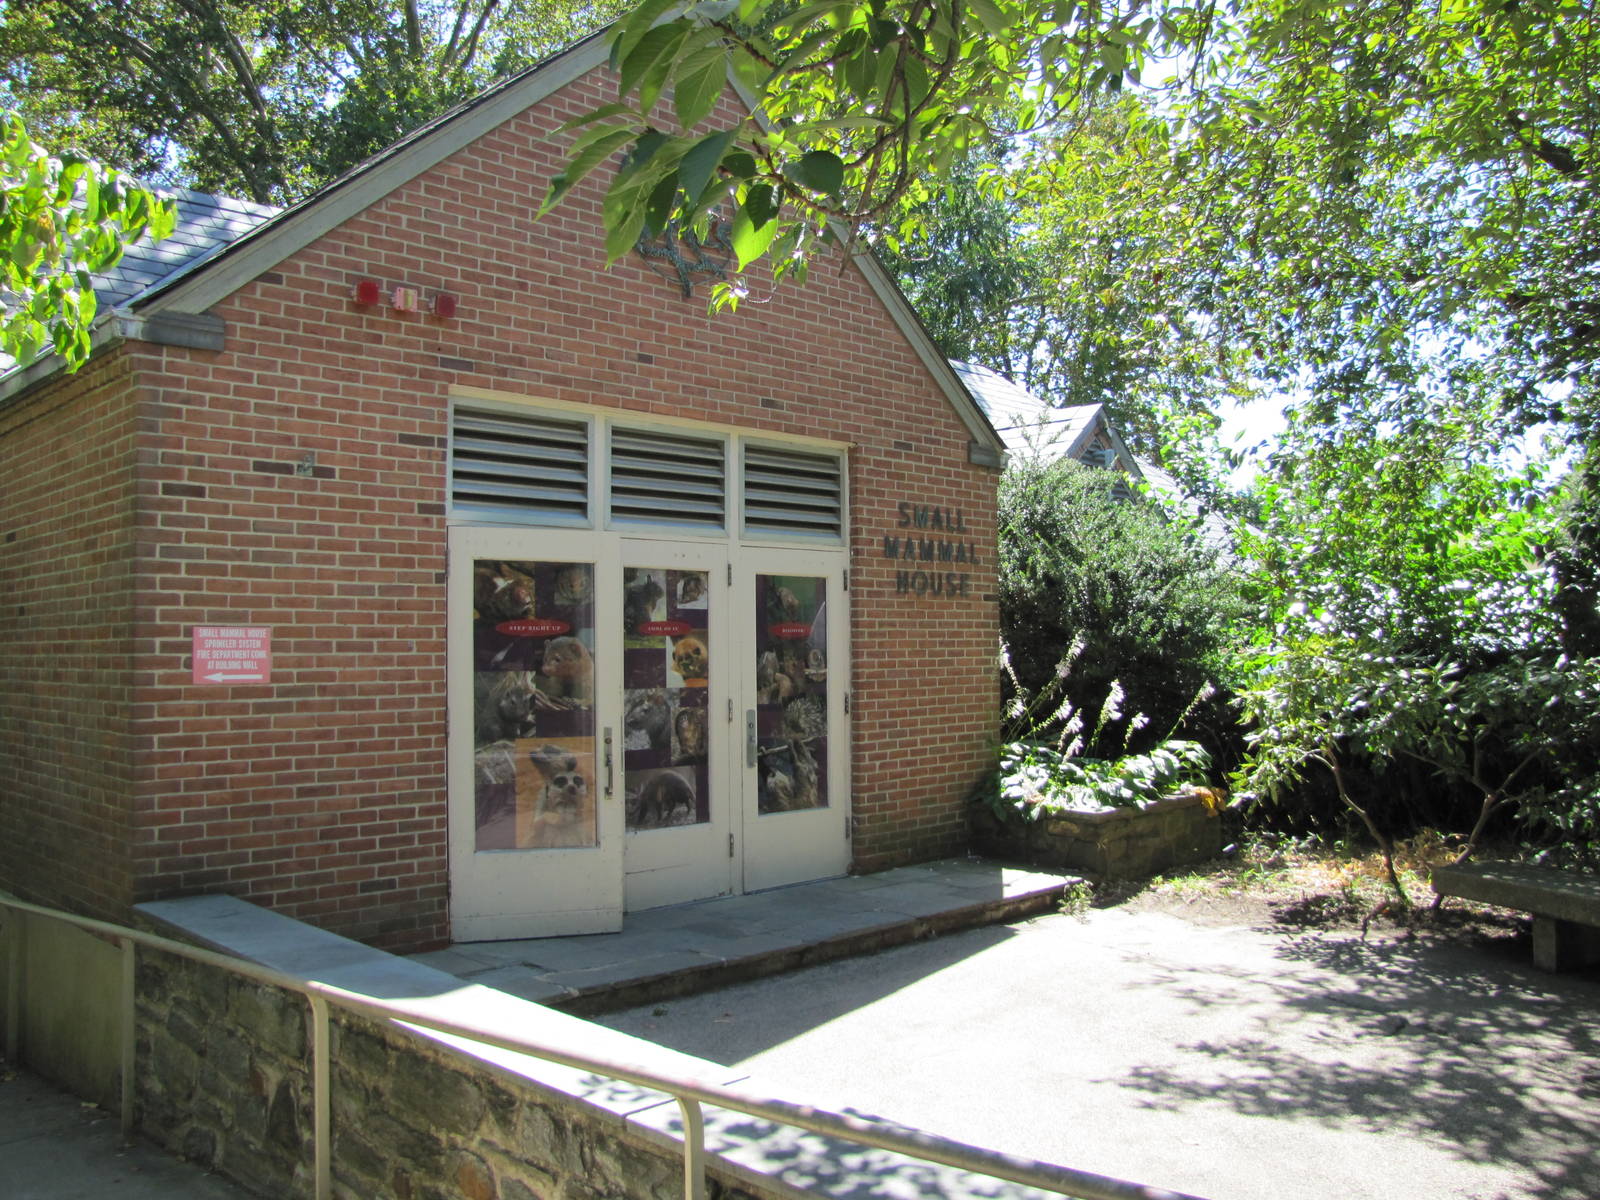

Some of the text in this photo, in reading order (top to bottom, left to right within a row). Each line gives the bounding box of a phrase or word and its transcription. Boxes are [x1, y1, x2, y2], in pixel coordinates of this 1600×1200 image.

[898, 501, 966, 533] SMALL
[884, 535, 980, 565] MAMMAL
[896, 569, 969, 597] HOUSE
[199, 628, 267, 639] SMALL MAMMAL HOUSE
[204, 639, 262, 649] SPRINKLER SYSTEM
[196, 649, 210, 659] FIRE
[212, 649, 250, 659] DEPARTMENT
[207, 660, 215, 669] AT
[242, 660, 258, 669] WALL
